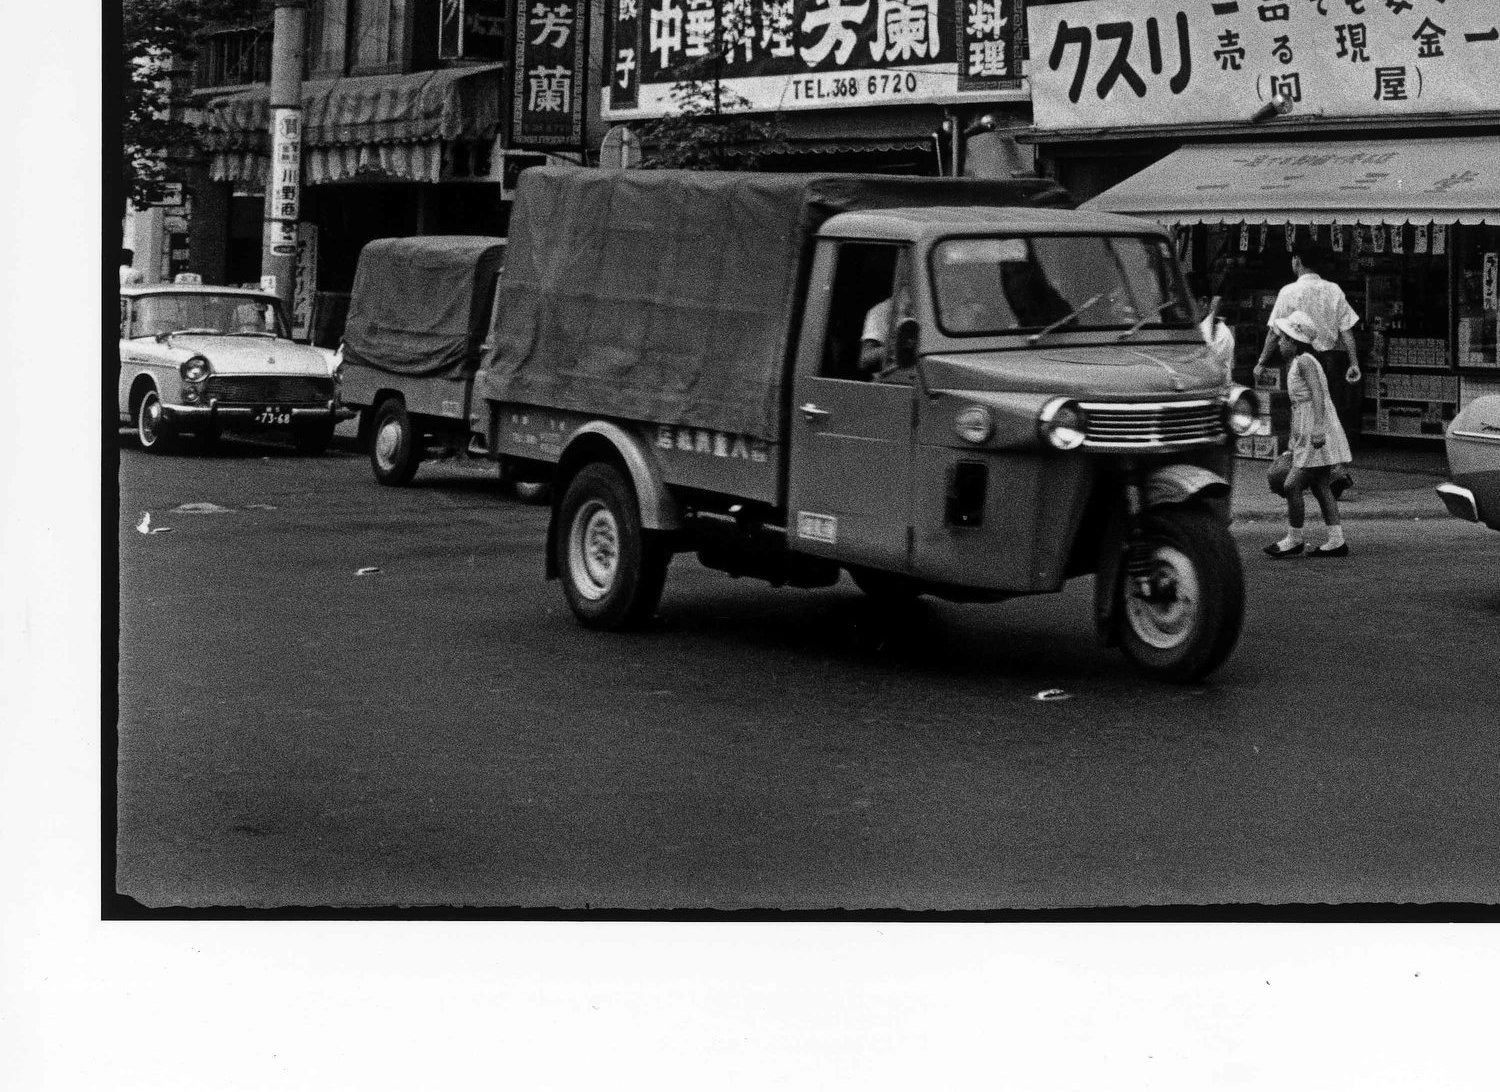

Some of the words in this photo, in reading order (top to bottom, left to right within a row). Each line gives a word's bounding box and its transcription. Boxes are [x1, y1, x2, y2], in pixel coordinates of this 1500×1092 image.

[529, 2, 573, 114] 芳蘭
[867, 72, 918, 95] 6720
[1050, 11, 1192, 104] クスリ
